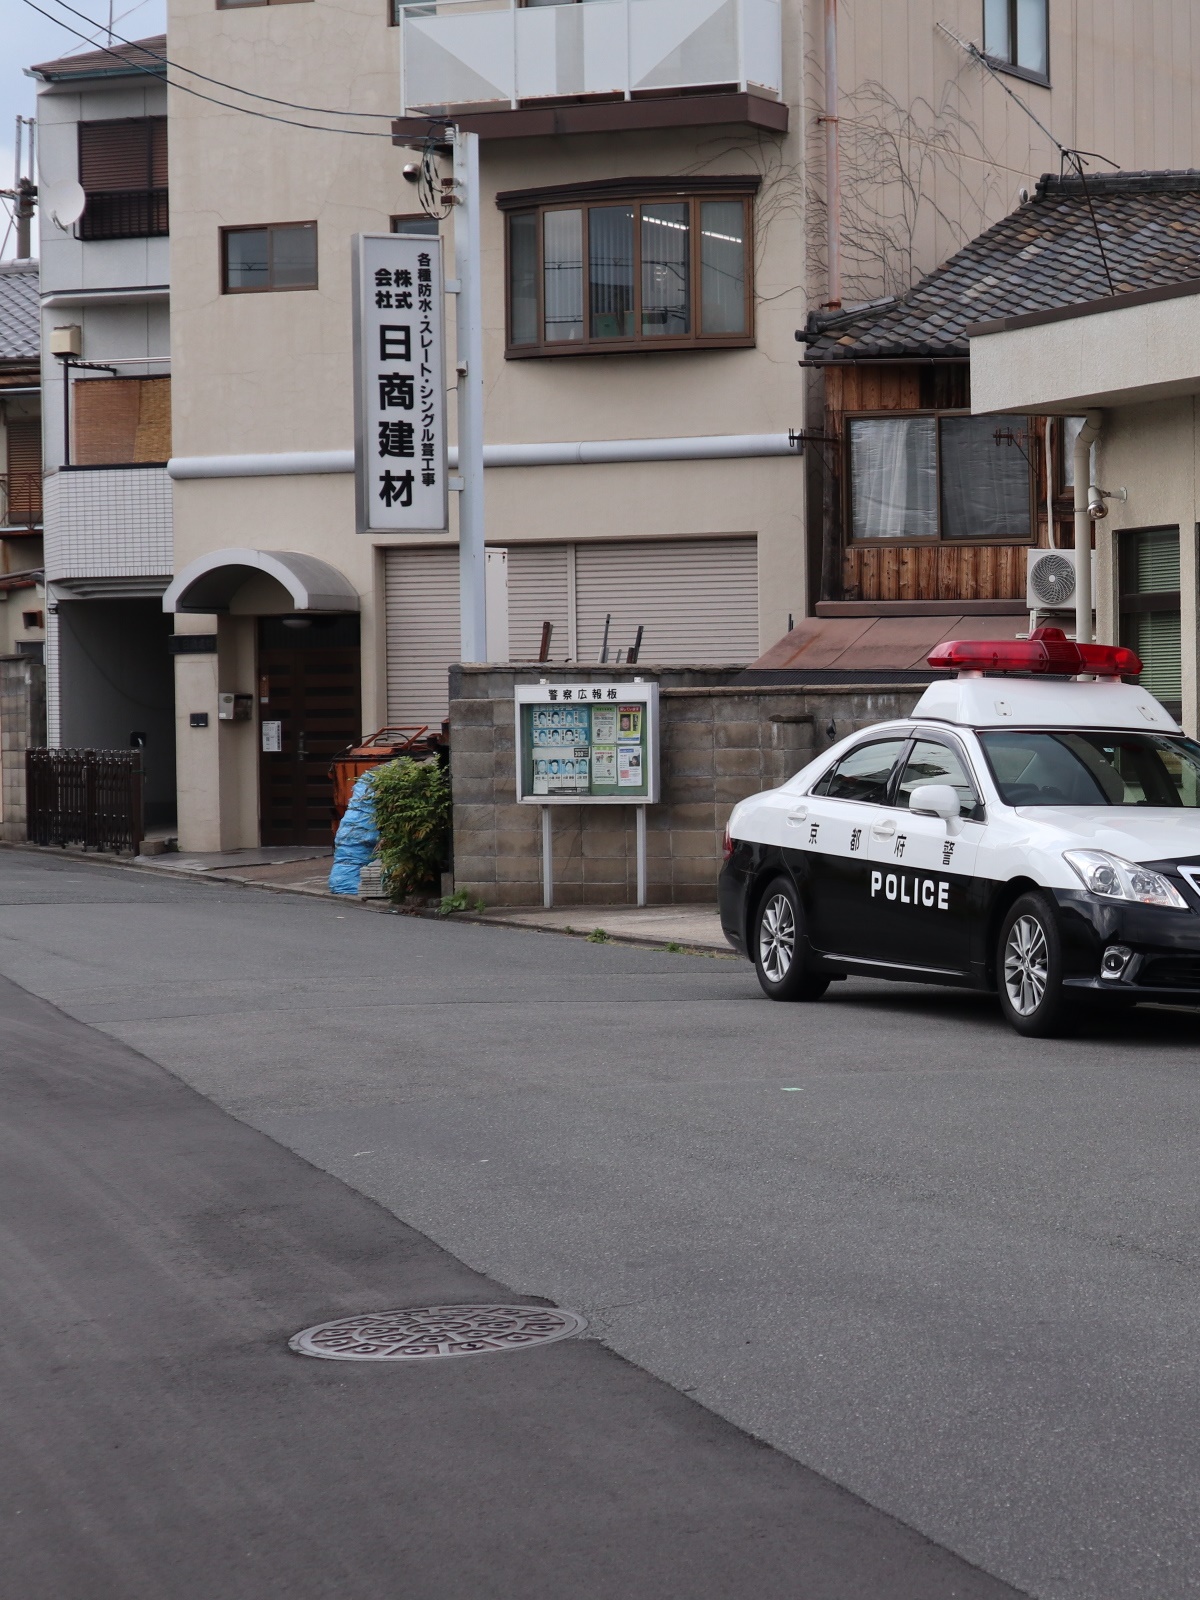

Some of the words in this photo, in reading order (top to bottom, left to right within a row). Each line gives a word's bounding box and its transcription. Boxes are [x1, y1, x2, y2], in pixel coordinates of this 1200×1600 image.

[374, 267, 393, 310] 会社
[393, 268, 414, 310] 株式
[417, 252, 436, 488] 各種防水・スレート・シングル葺工事
[377, 324, 415, 508] 日商建材
[548, 688, 618, 701] 警察広報板
[808, 821, 956, 866] 京都府警
[870, 870, 950, 910] POLICE
